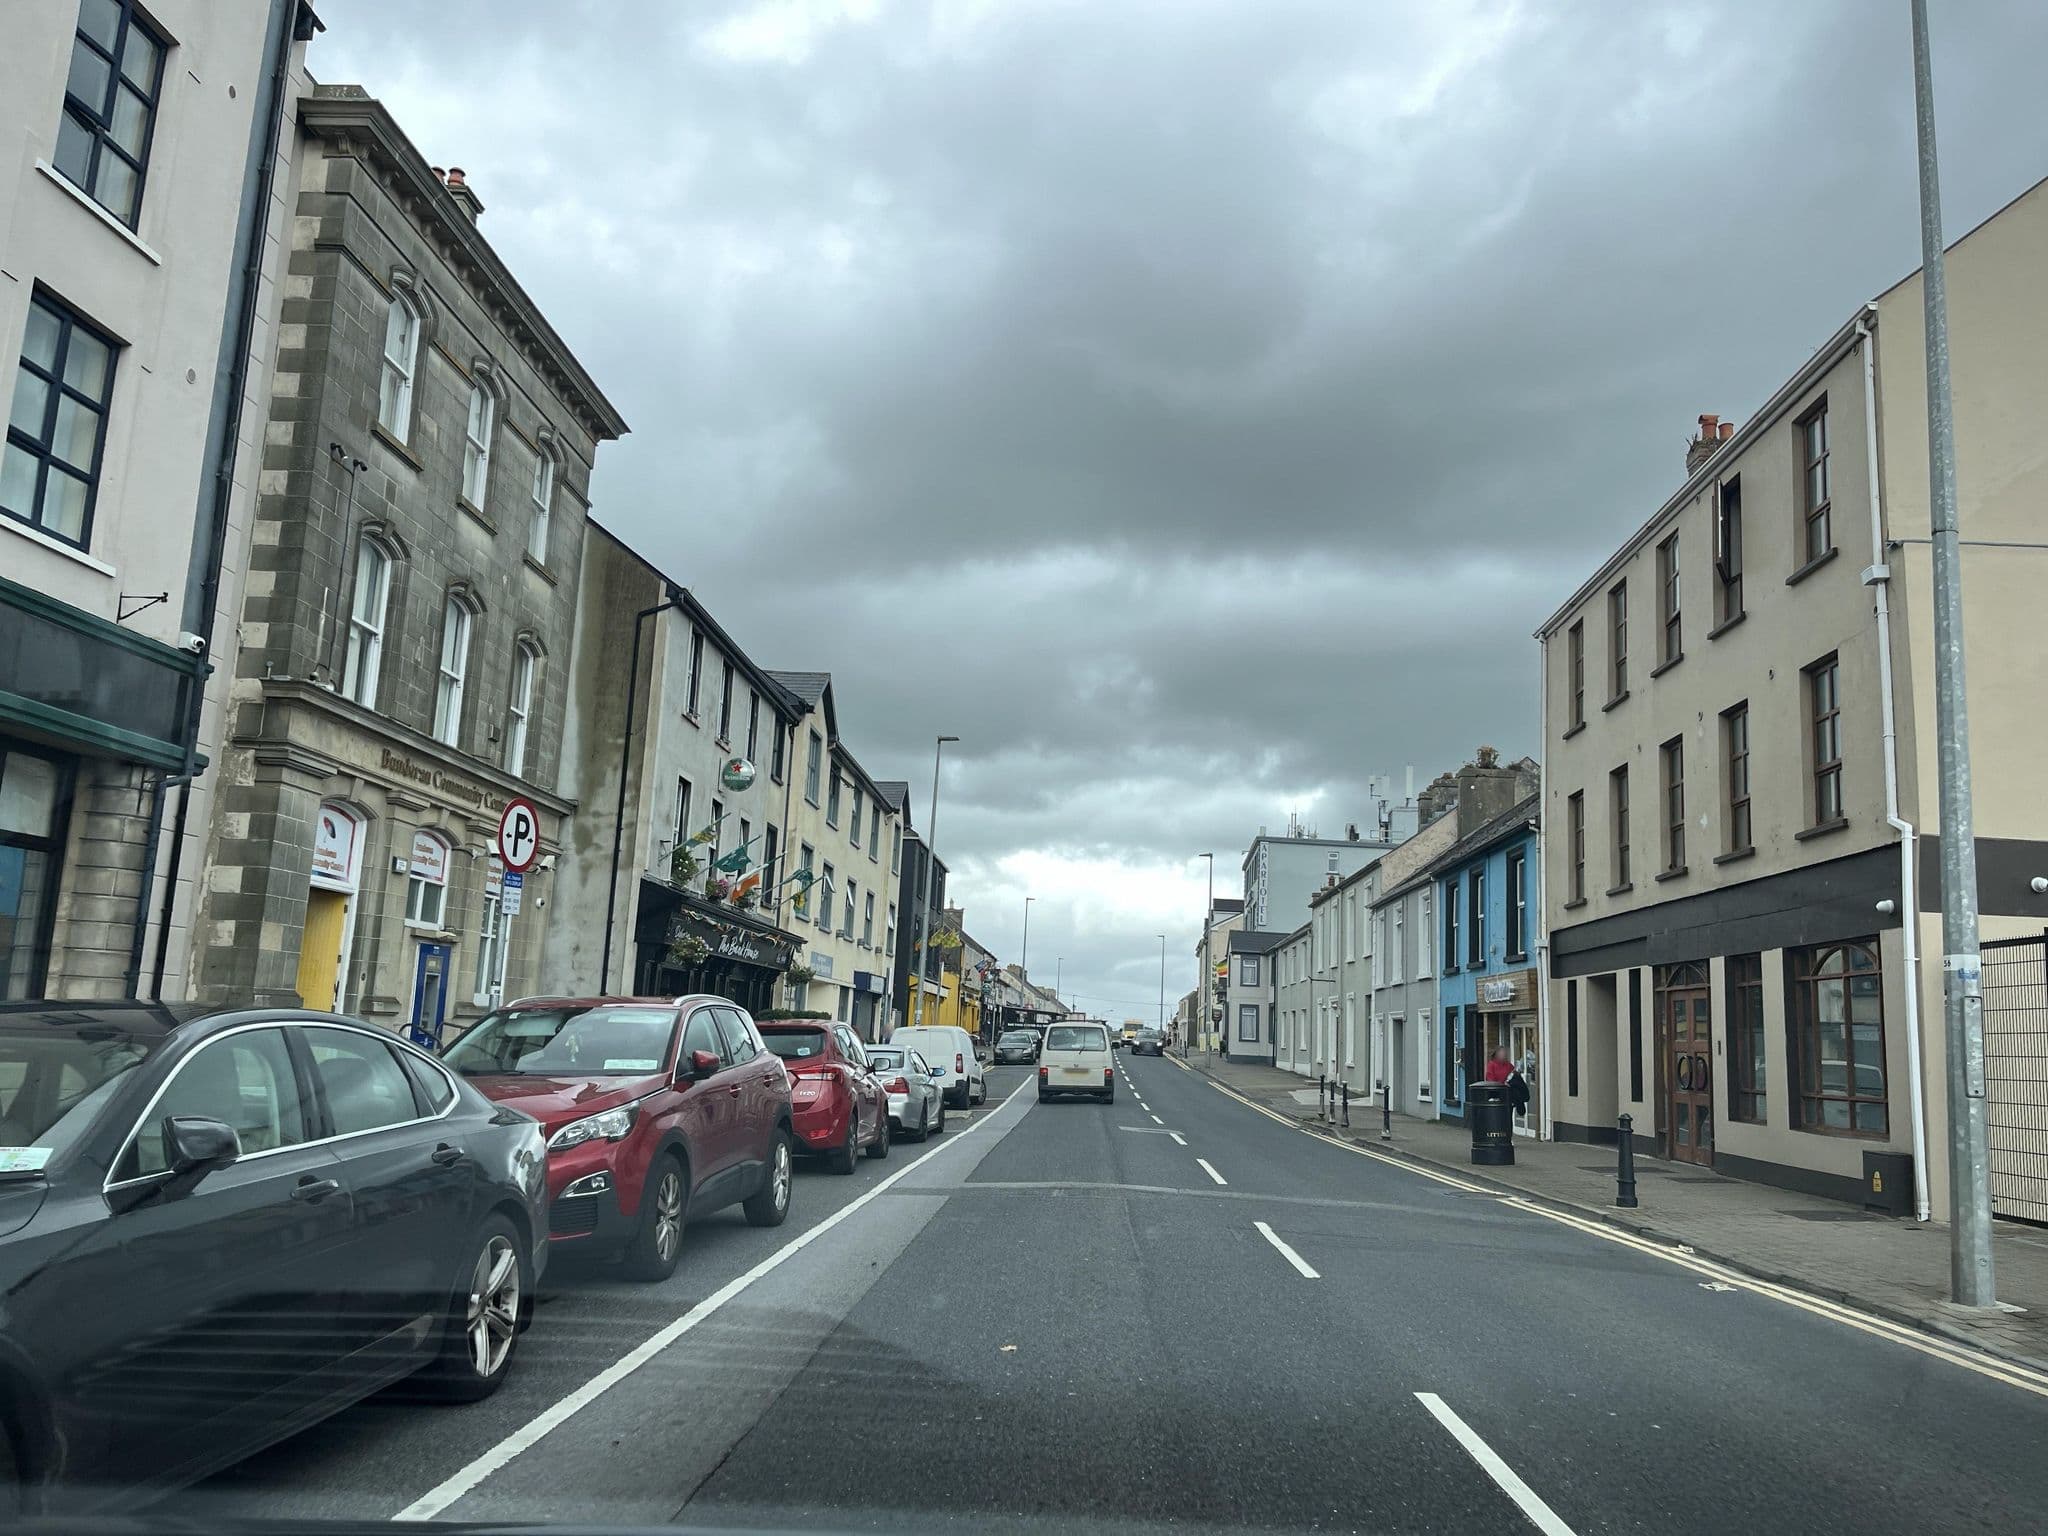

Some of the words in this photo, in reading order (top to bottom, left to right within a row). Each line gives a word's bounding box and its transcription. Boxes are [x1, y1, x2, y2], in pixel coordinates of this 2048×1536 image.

[381, 747, 432, 786] Bundoran
[432, 768, 484, 809] Community
[512, 812, 530, 858] P
